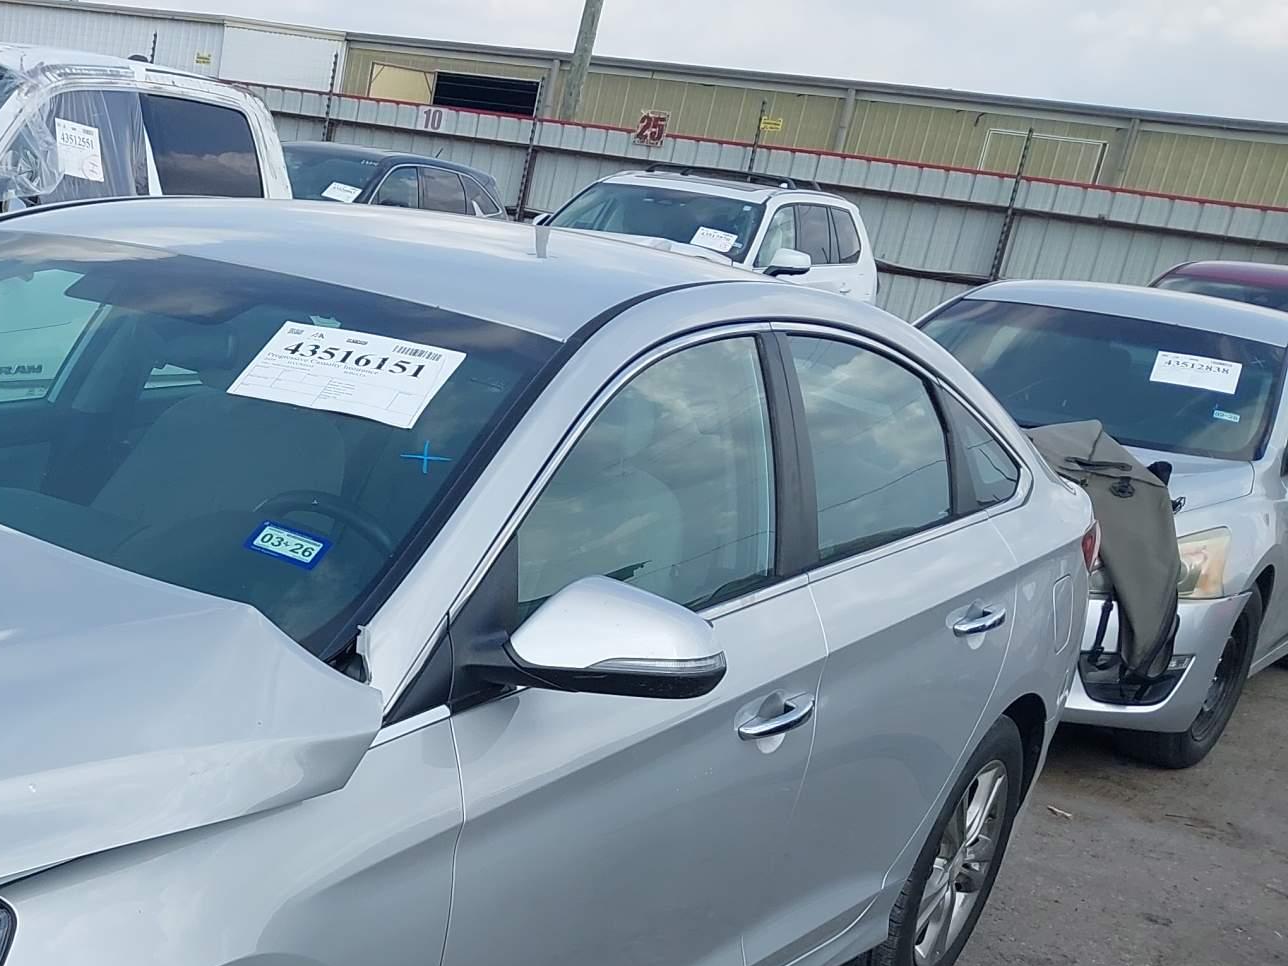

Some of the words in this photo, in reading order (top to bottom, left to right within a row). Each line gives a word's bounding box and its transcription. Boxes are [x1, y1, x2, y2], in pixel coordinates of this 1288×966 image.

[423, 109, 443, 131] 10
[636, 114, 666, 142] 25
[283, 341, 427, 378] 43516151
[260, 533, 315, 558] 03-26
